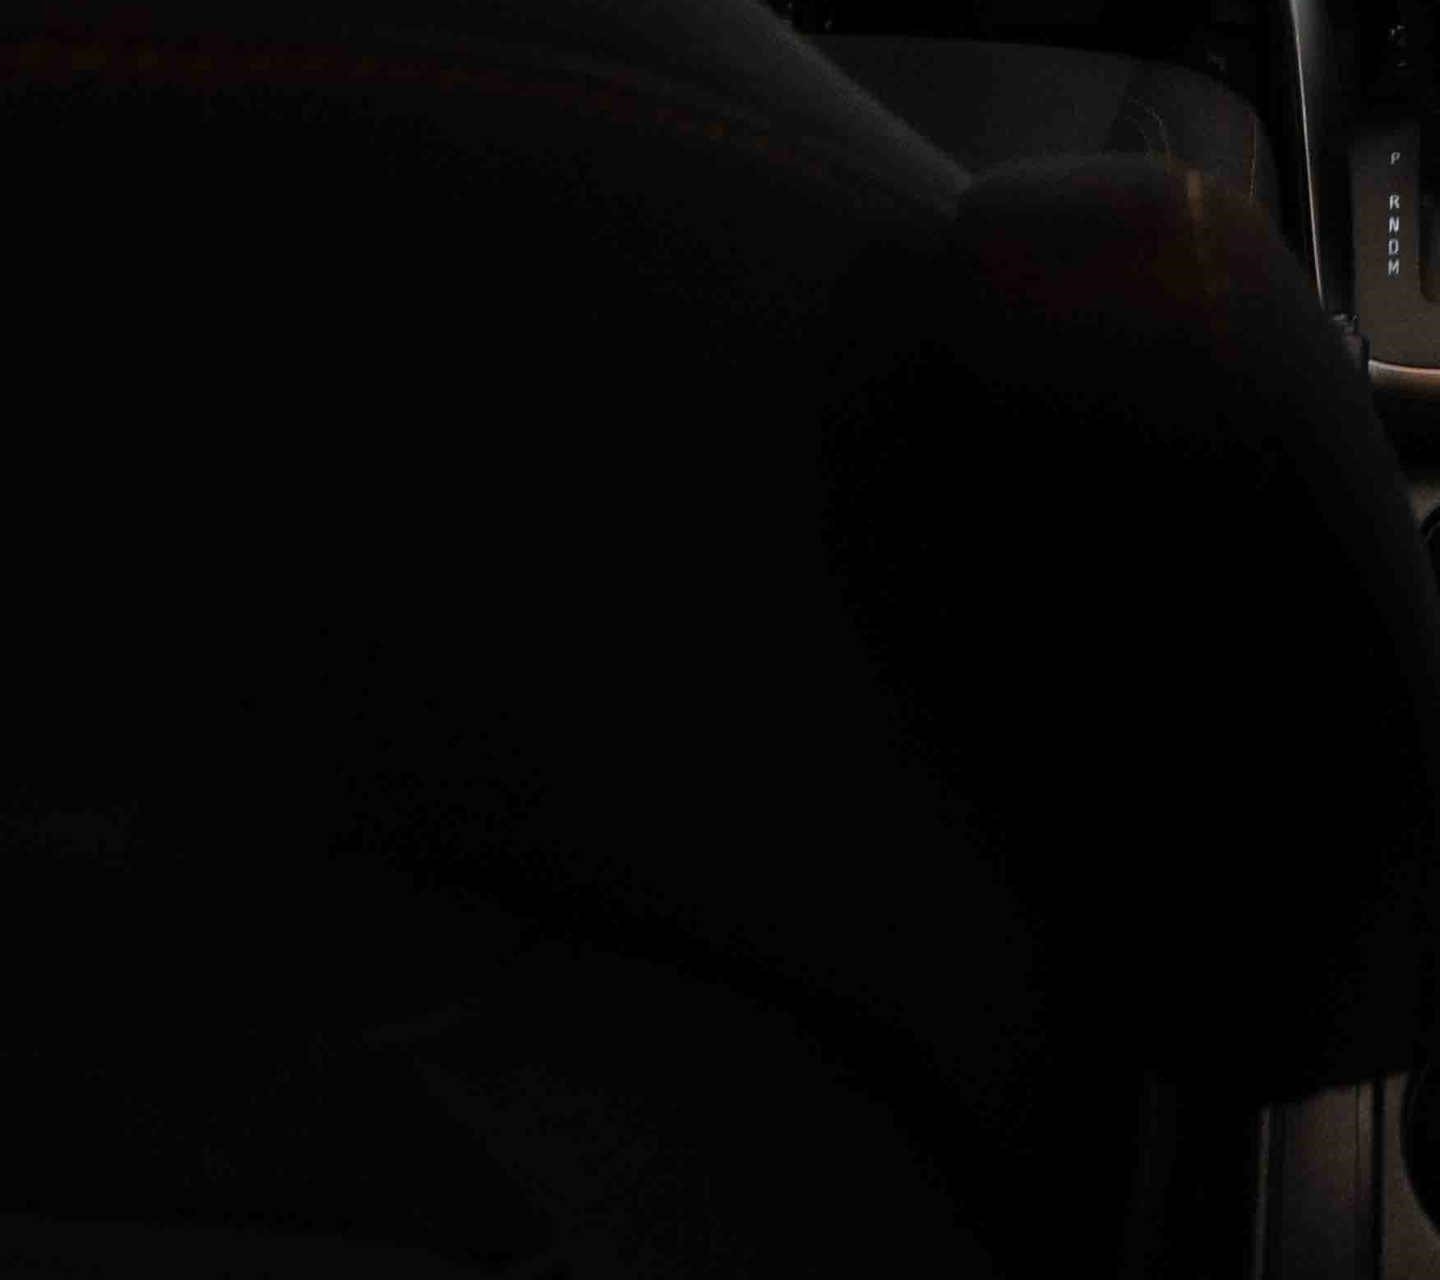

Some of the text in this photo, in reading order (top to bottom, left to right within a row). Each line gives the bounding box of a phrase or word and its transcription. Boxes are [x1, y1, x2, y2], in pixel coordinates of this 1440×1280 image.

[1390, 151, 1401, 165] P
[1389, 194, 1400, 209] R
[1388, 216, 1400, 232] N
[1387, 240, 1399, 256] D
[1387, 258, 1400, 275] M
